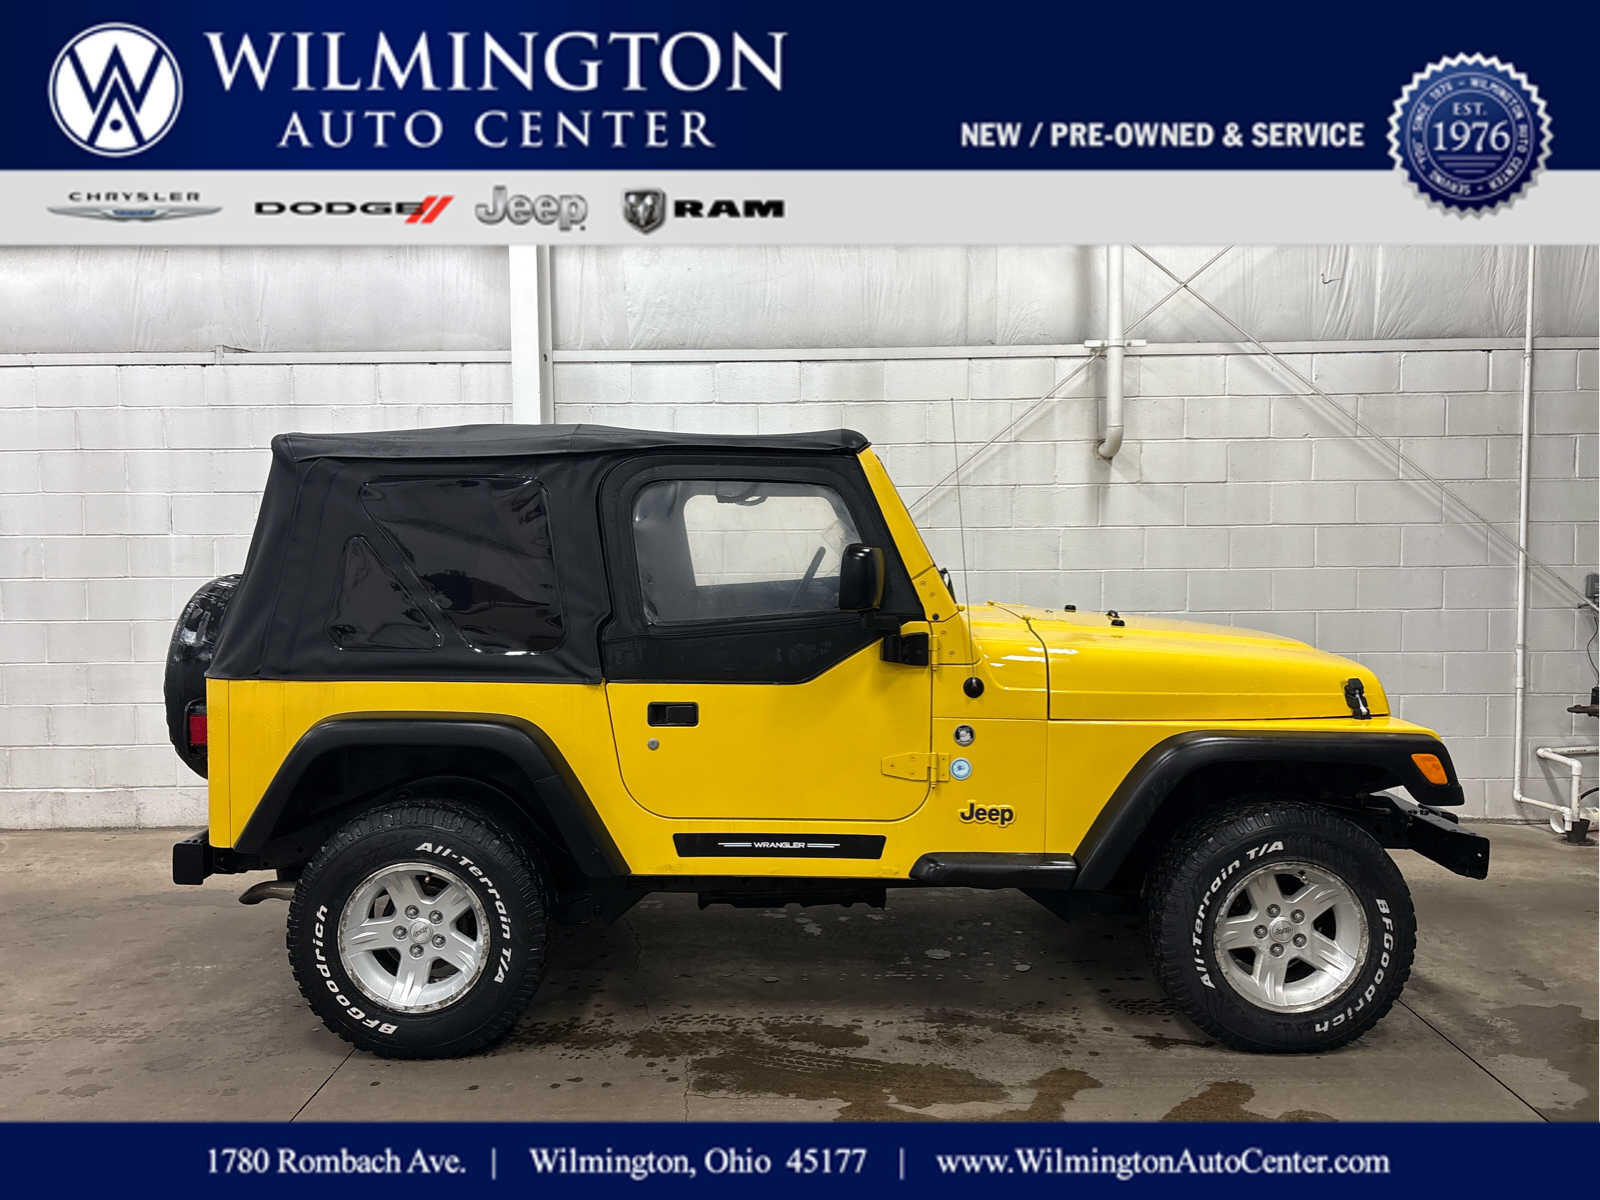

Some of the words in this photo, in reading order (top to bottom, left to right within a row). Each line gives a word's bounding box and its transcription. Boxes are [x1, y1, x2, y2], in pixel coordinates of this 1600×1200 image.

[753, 841, 806, 849] WRANGLER
[960, 802, 1015, 826] Jeep
[312, 904, 399, 1035] BFGoodrich
[415, 841, 513, 940] All-Terrain
[493, 947, 513, 985] T/A
[1192, 859, 1242, 990] All-Terrain
[1246, 840, 1285, 860] T/A
[1314, 898, 1395, 1033] BFGoodrich
